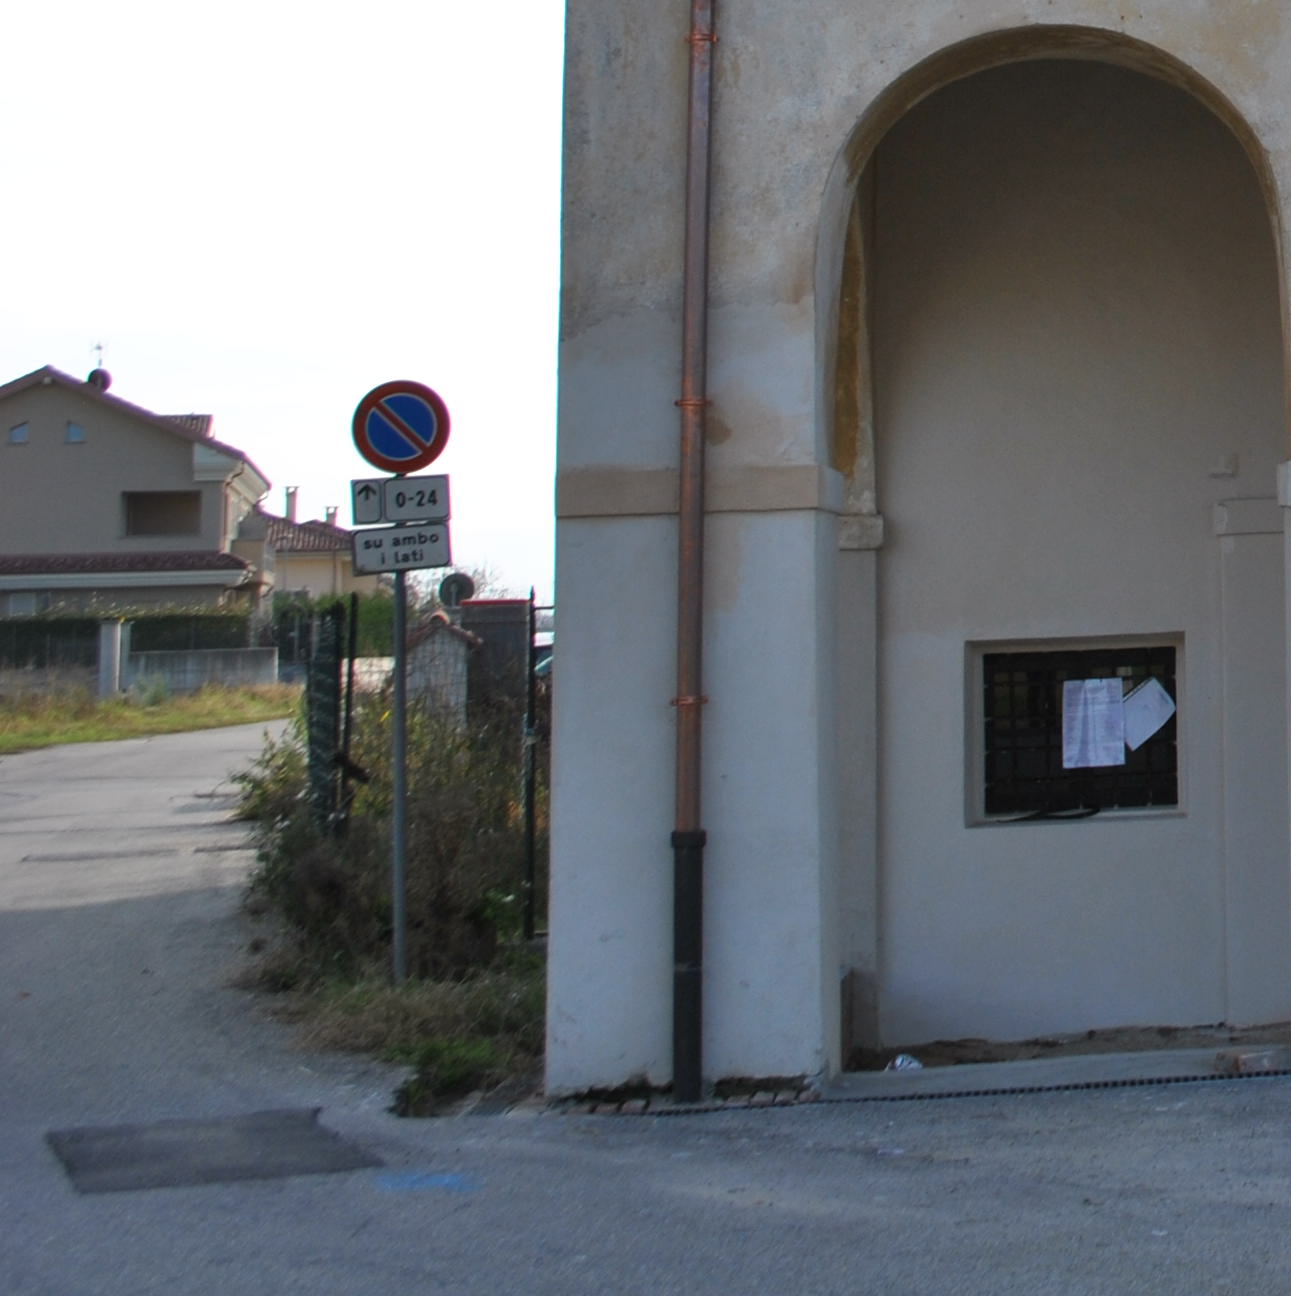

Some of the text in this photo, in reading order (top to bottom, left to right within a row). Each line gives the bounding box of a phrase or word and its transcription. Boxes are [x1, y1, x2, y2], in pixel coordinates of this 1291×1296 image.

[395, 489, 438, 509] 0-24
[363, 532, 439, 550] su ambo
[381, 549, 425, 565] i lati
